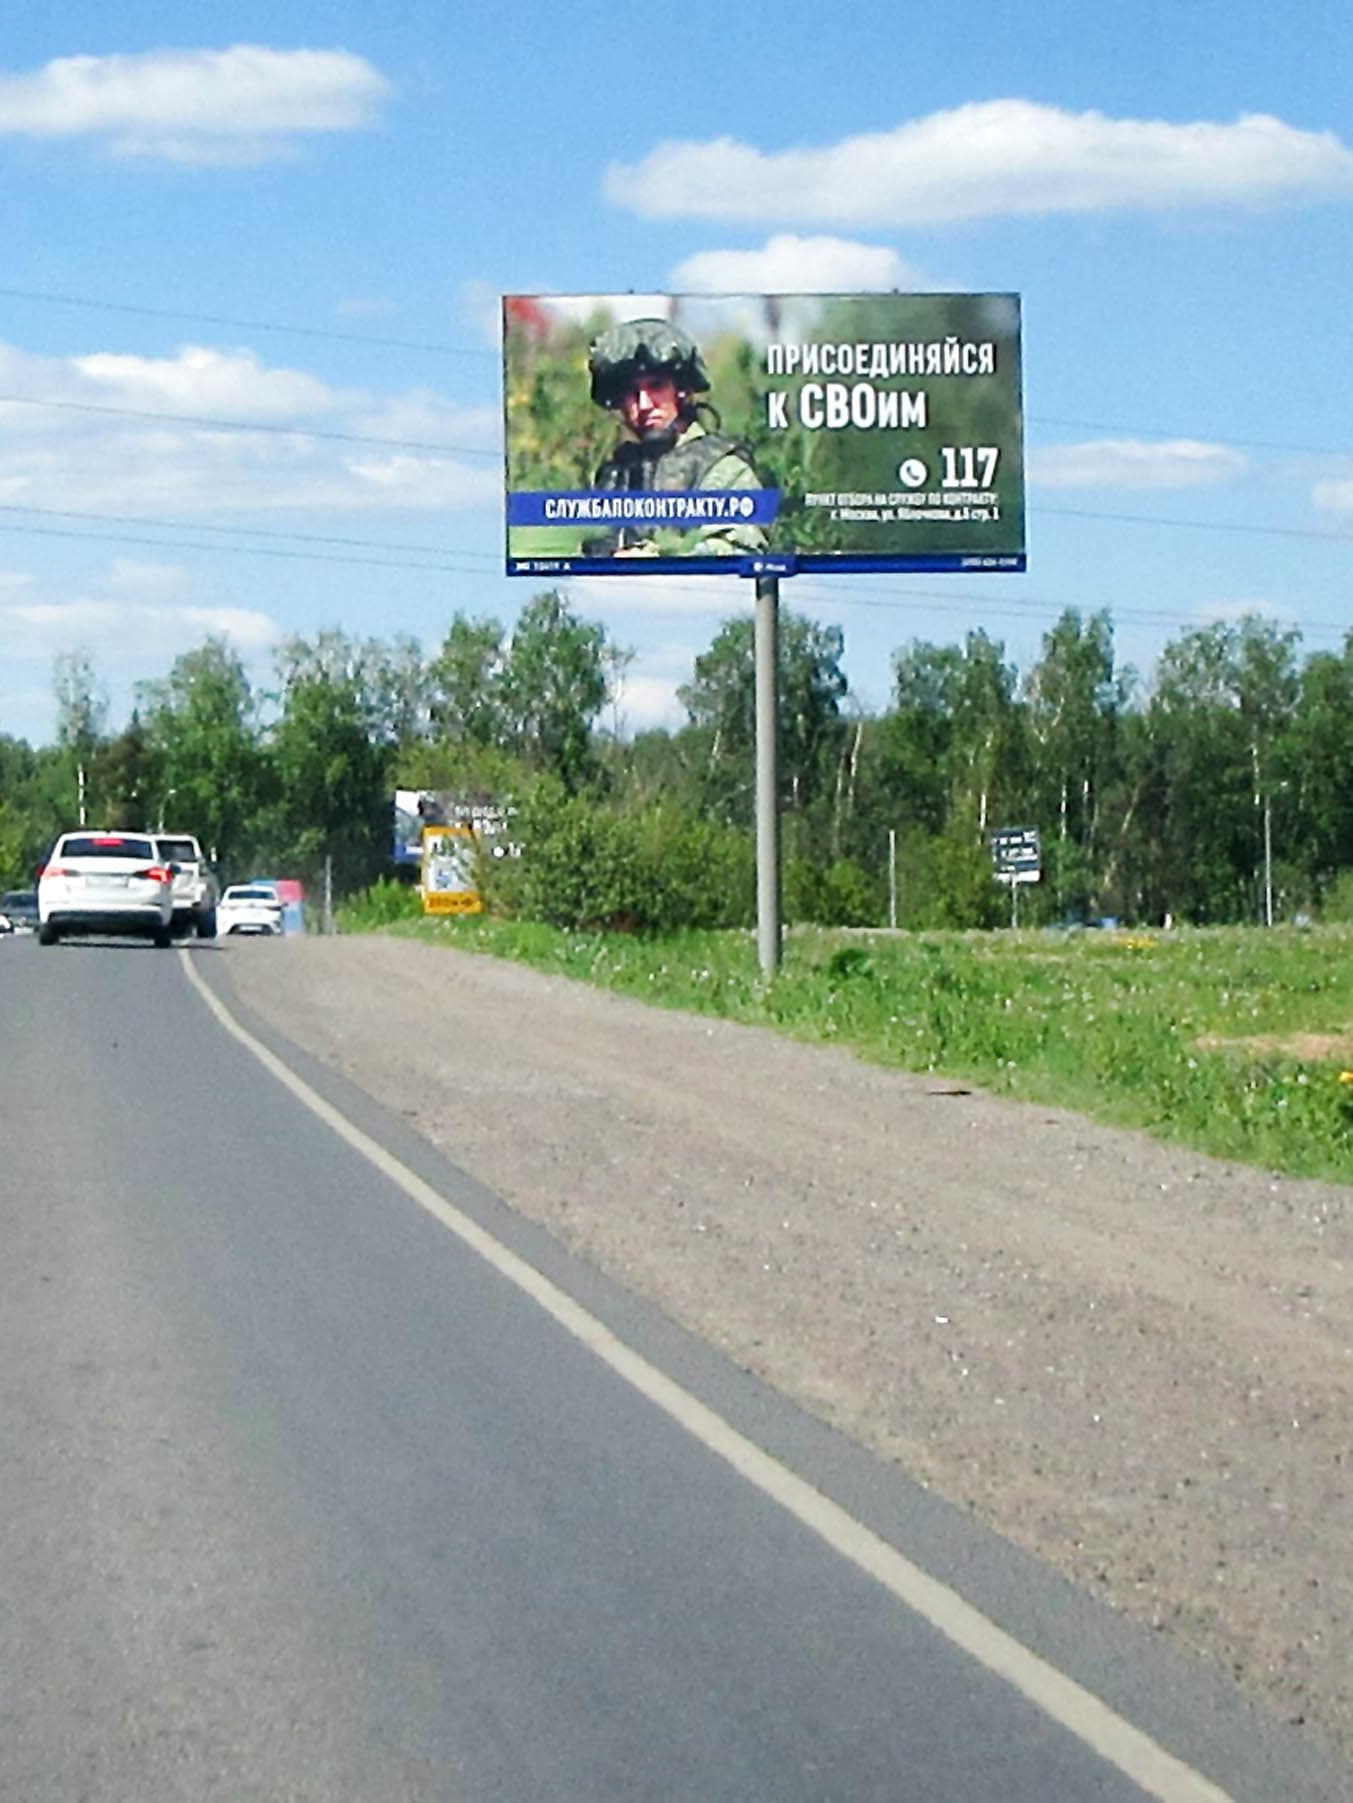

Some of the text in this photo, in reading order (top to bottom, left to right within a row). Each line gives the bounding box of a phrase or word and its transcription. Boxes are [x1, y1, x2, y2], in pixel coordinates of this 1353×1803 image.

[768, 337, 995, 377] ПРИСОЕДИНЯЙСЯ
[941, 447, 999, 488] 117
[544, 496, 755, 520] СЛУЖБАПОКОНТРАКТУ.РФ
